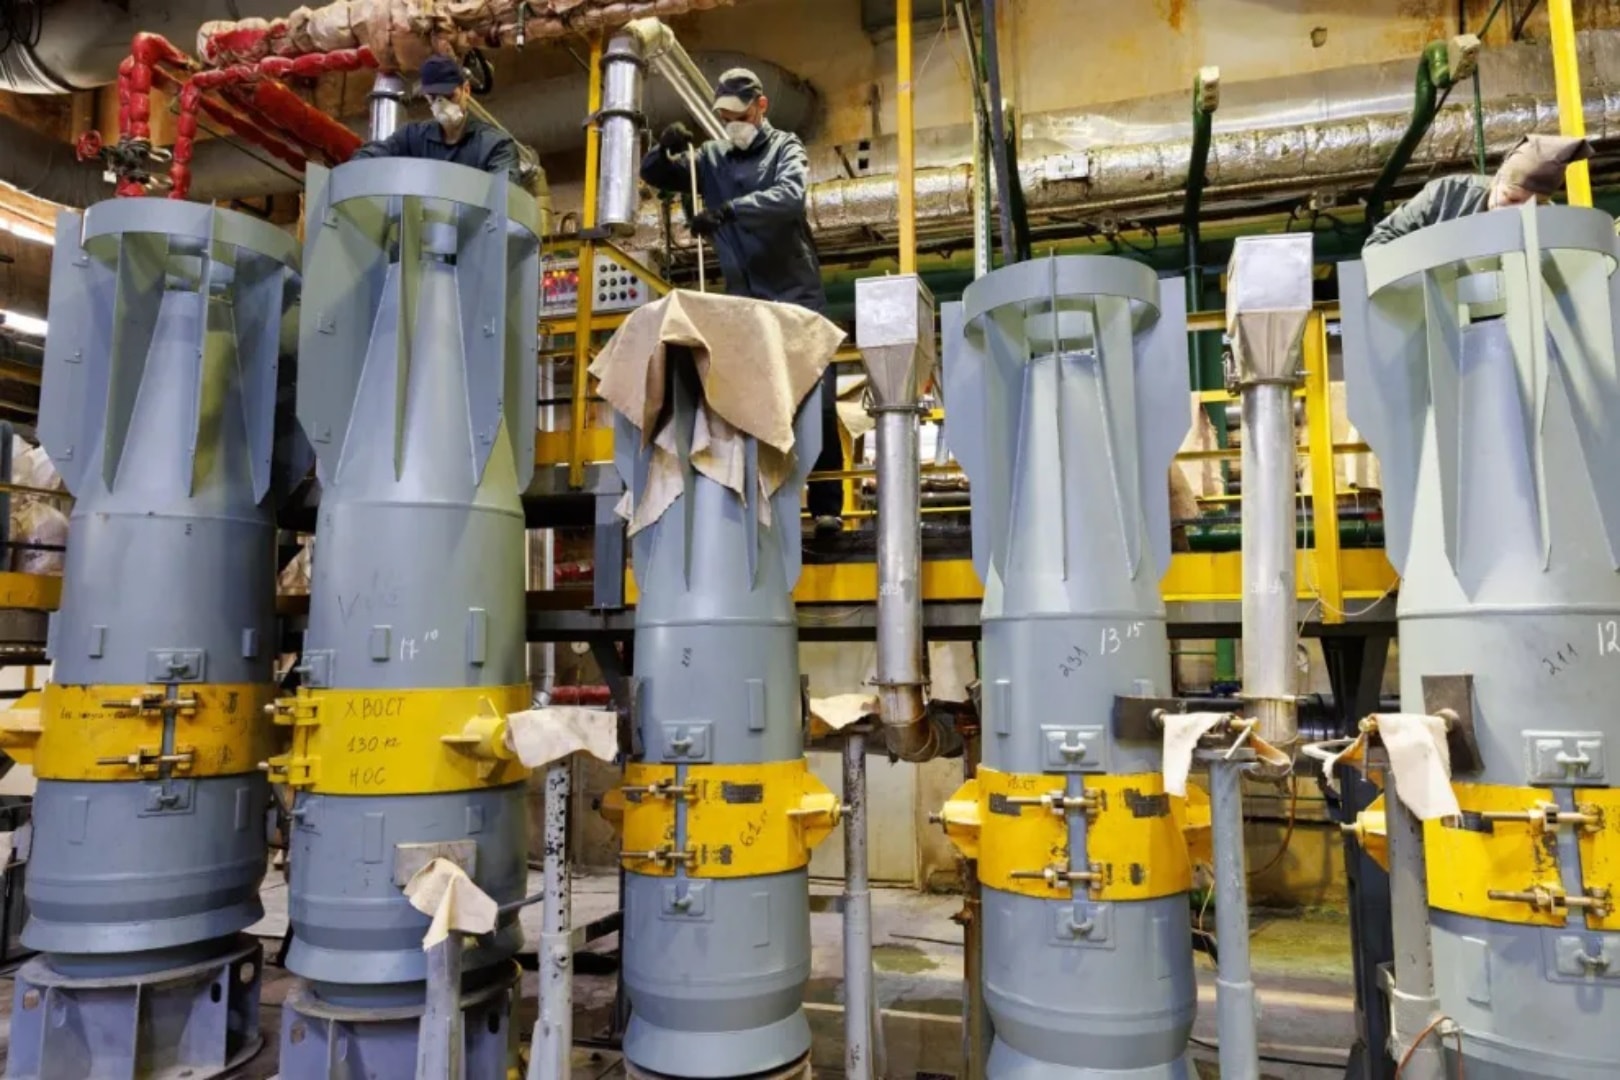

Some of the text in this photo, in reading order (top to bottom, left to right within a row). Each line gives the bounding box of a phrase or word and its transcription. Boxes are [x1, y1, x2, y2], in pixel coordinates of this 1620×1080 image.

[1100, 627, 1121, 655] 13
[1597, 619, 1620, 656] 12
[347, 735, 379, 753] 130
